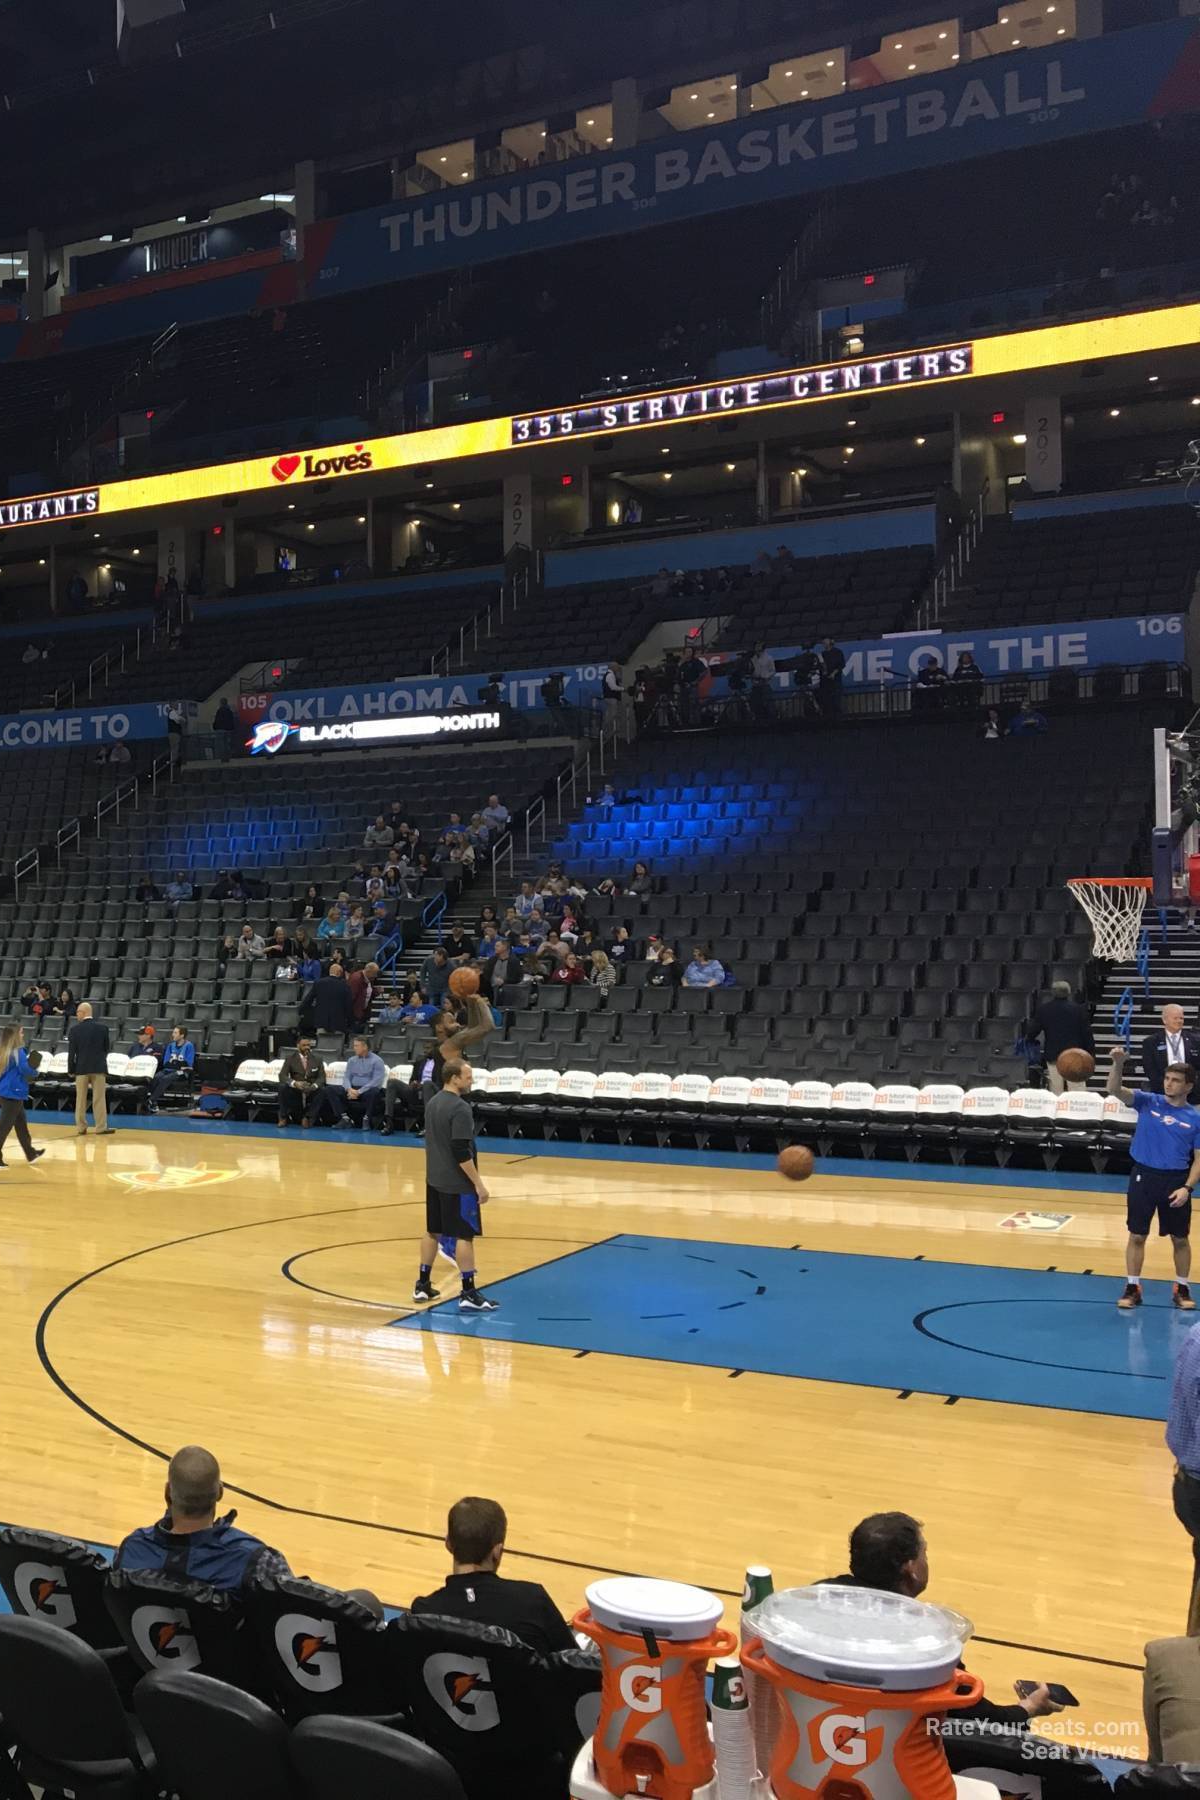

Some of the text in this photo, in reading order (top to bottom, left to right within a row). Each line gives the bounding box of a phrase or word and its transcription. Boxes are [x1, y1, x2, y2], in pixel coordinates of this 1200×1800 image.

[380, 61, 1085, 251] THUNDER BASKETBALL
[143, 230, 208, 273] THUNDER
[517, 351, 966, 442] 355 SERVICE CENTERS
[1037, 418, 1048, 466] 209
[512, 493, 522, 535] 207
[988, 633, 1089, 672] THE
[1136, 618, 1182, 637] 106
[90, 714, 130, 739] TO
[241, 695, 268, 710] 105
[268, 684, 470, 720] OKLAHOMA
[300, 723, 354, 742] BLACK
[438, 712, 500, 732] MONTH
[14, 1562, 77, 1629] G
[131, 1605, 202, 1671] G
[275, 1614, 343, 1693] G
[423, 1652, 500, 1731] G
[620, 1664, 663, 1713] G
[819, 1714, 866, 1766] G
